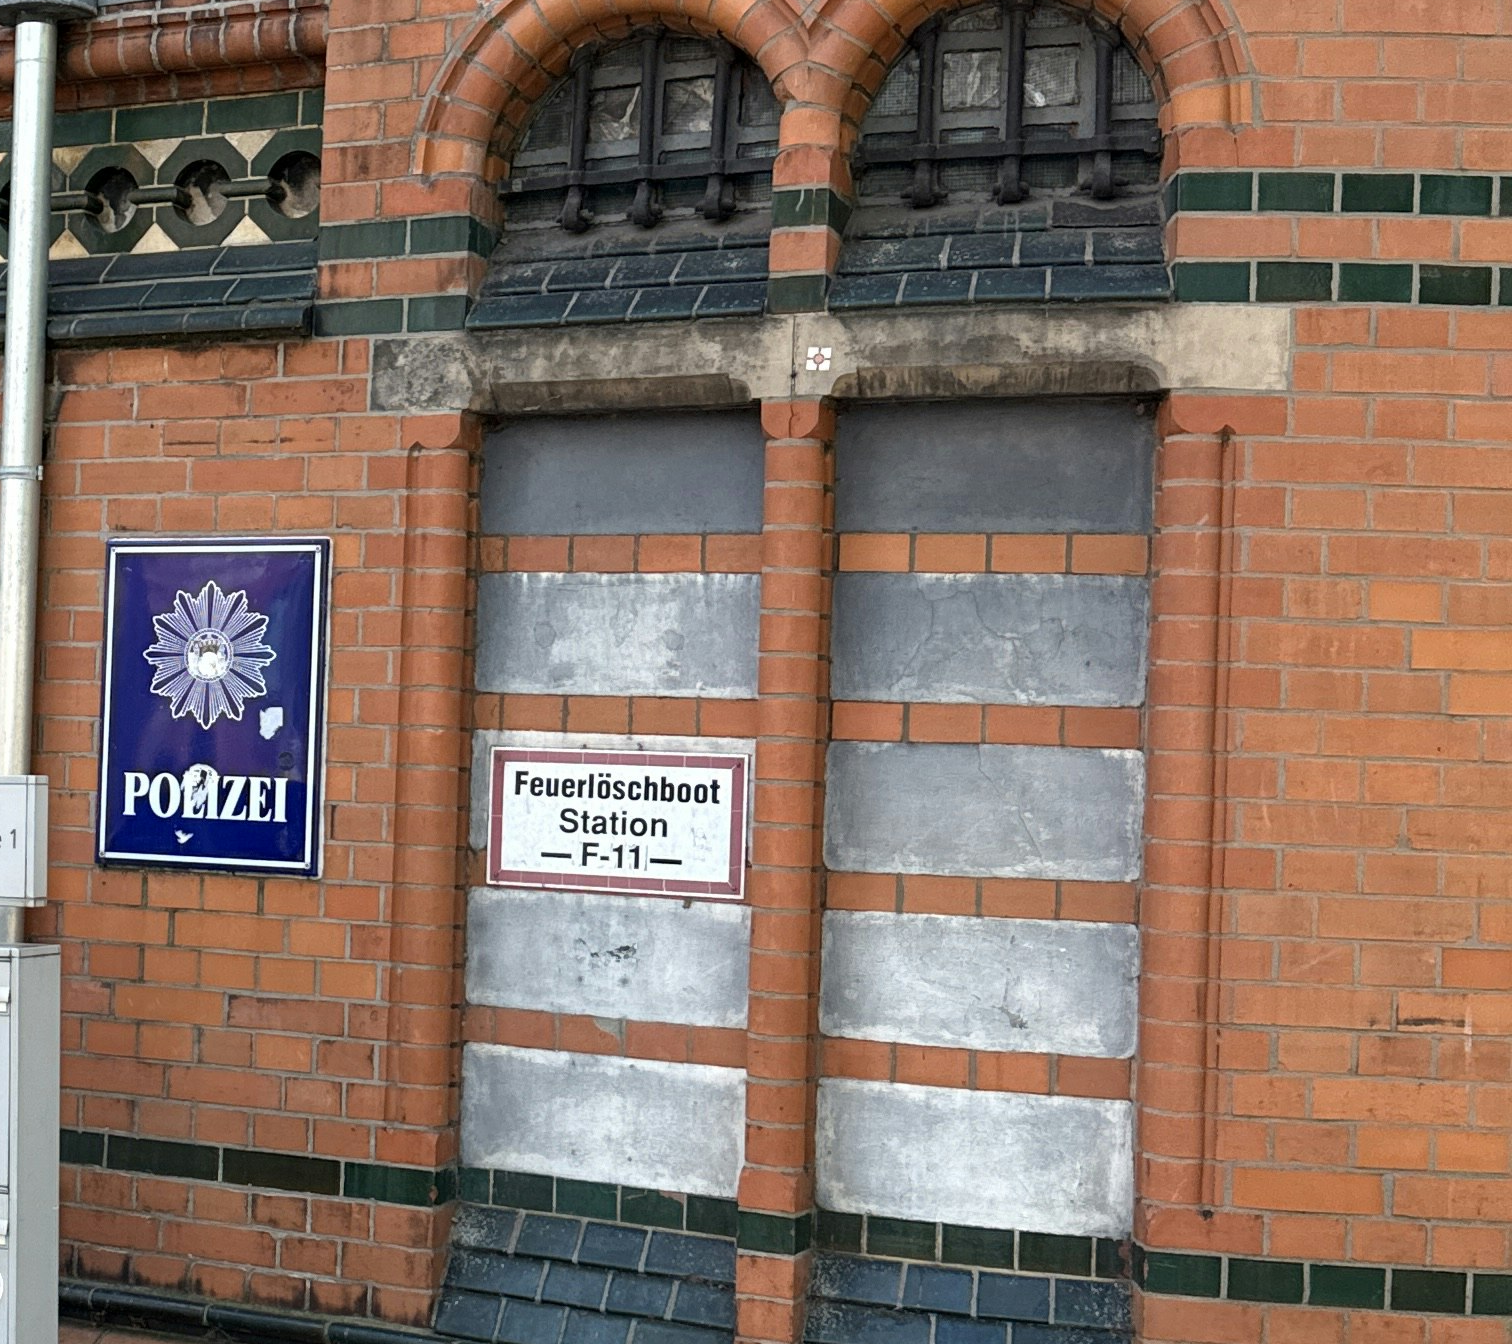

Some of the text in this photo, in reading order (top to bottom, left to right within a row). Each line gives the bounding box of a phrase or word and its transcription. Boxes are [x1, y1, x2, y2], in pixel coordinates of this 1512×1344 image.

[122, 771, 289, 823] POLIZEI
[514, 770, 721, 805] Feuerlöschboot
[9, 828, 18, 850] 1
[558, 807, 669, 838] Station
